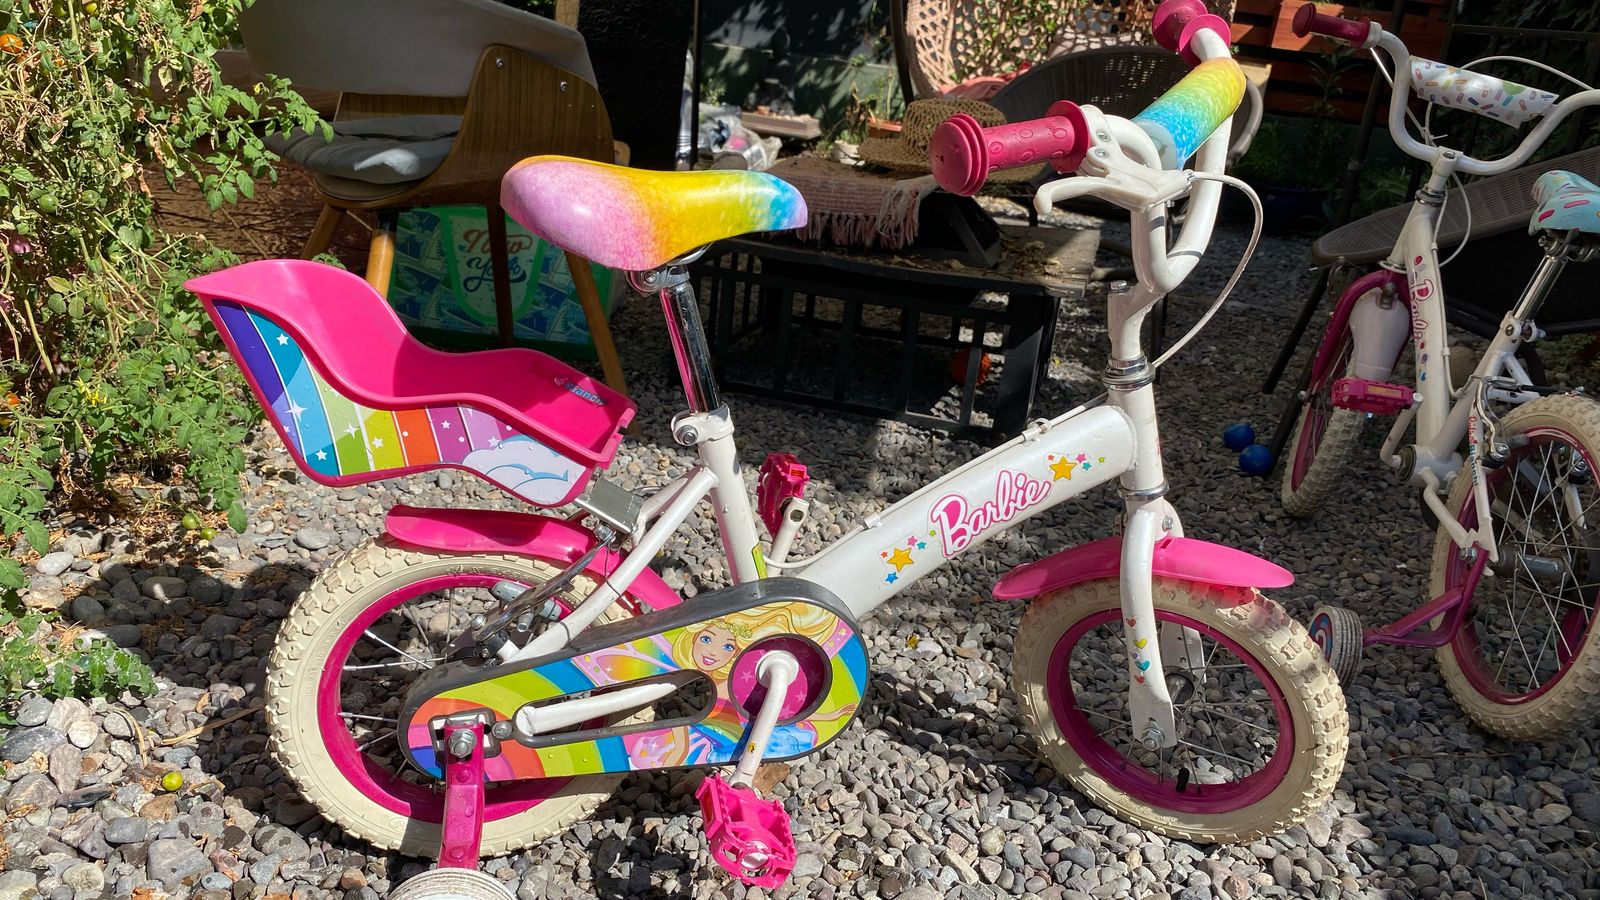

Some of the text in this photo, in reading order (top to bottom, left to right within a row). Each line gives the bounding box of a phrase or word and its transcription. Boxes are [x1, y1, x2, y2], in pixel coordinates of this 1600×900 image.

[463, 229, 533, 254] Nw
[463, 256, 527, 292] Yok
[930, 470, 1051, 559] Barbie
